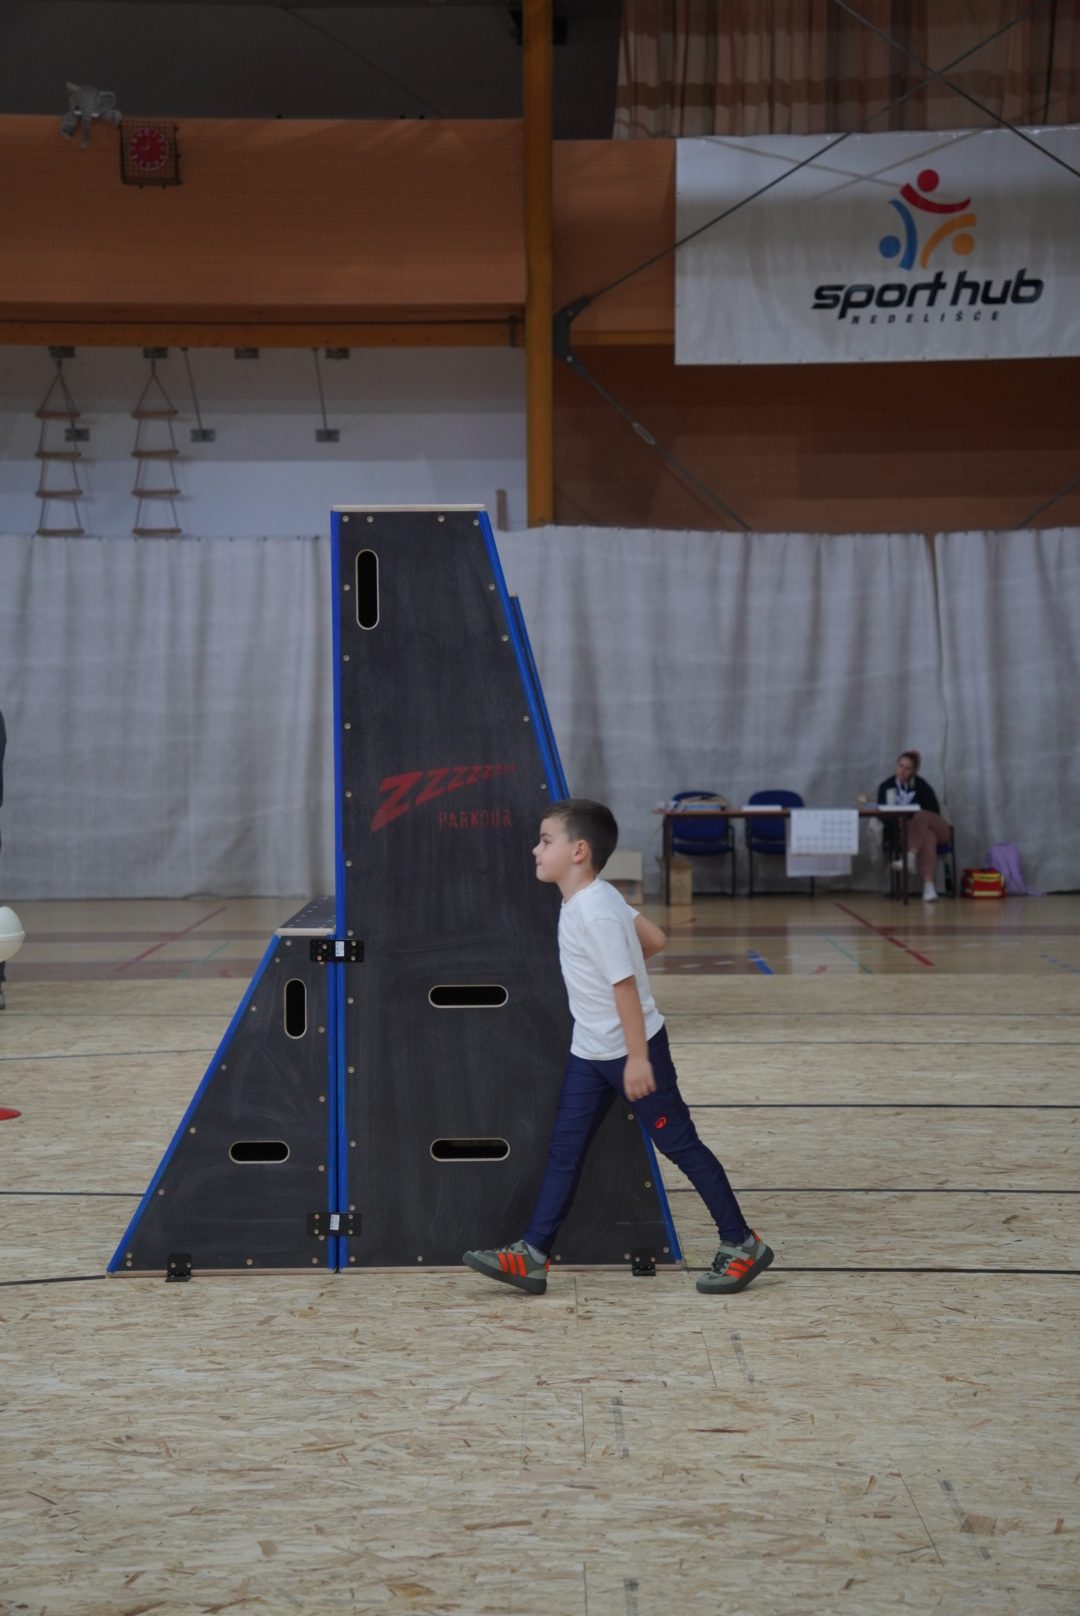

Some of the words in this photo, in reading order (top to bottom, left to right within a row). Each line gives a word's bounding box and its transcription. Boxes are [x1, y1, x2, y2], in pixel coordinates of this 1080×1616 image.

[811, 271, 947, 320] sport
[949, 267, 1044, 305] hub
[438, 808, 513, 832] PARKOUR
